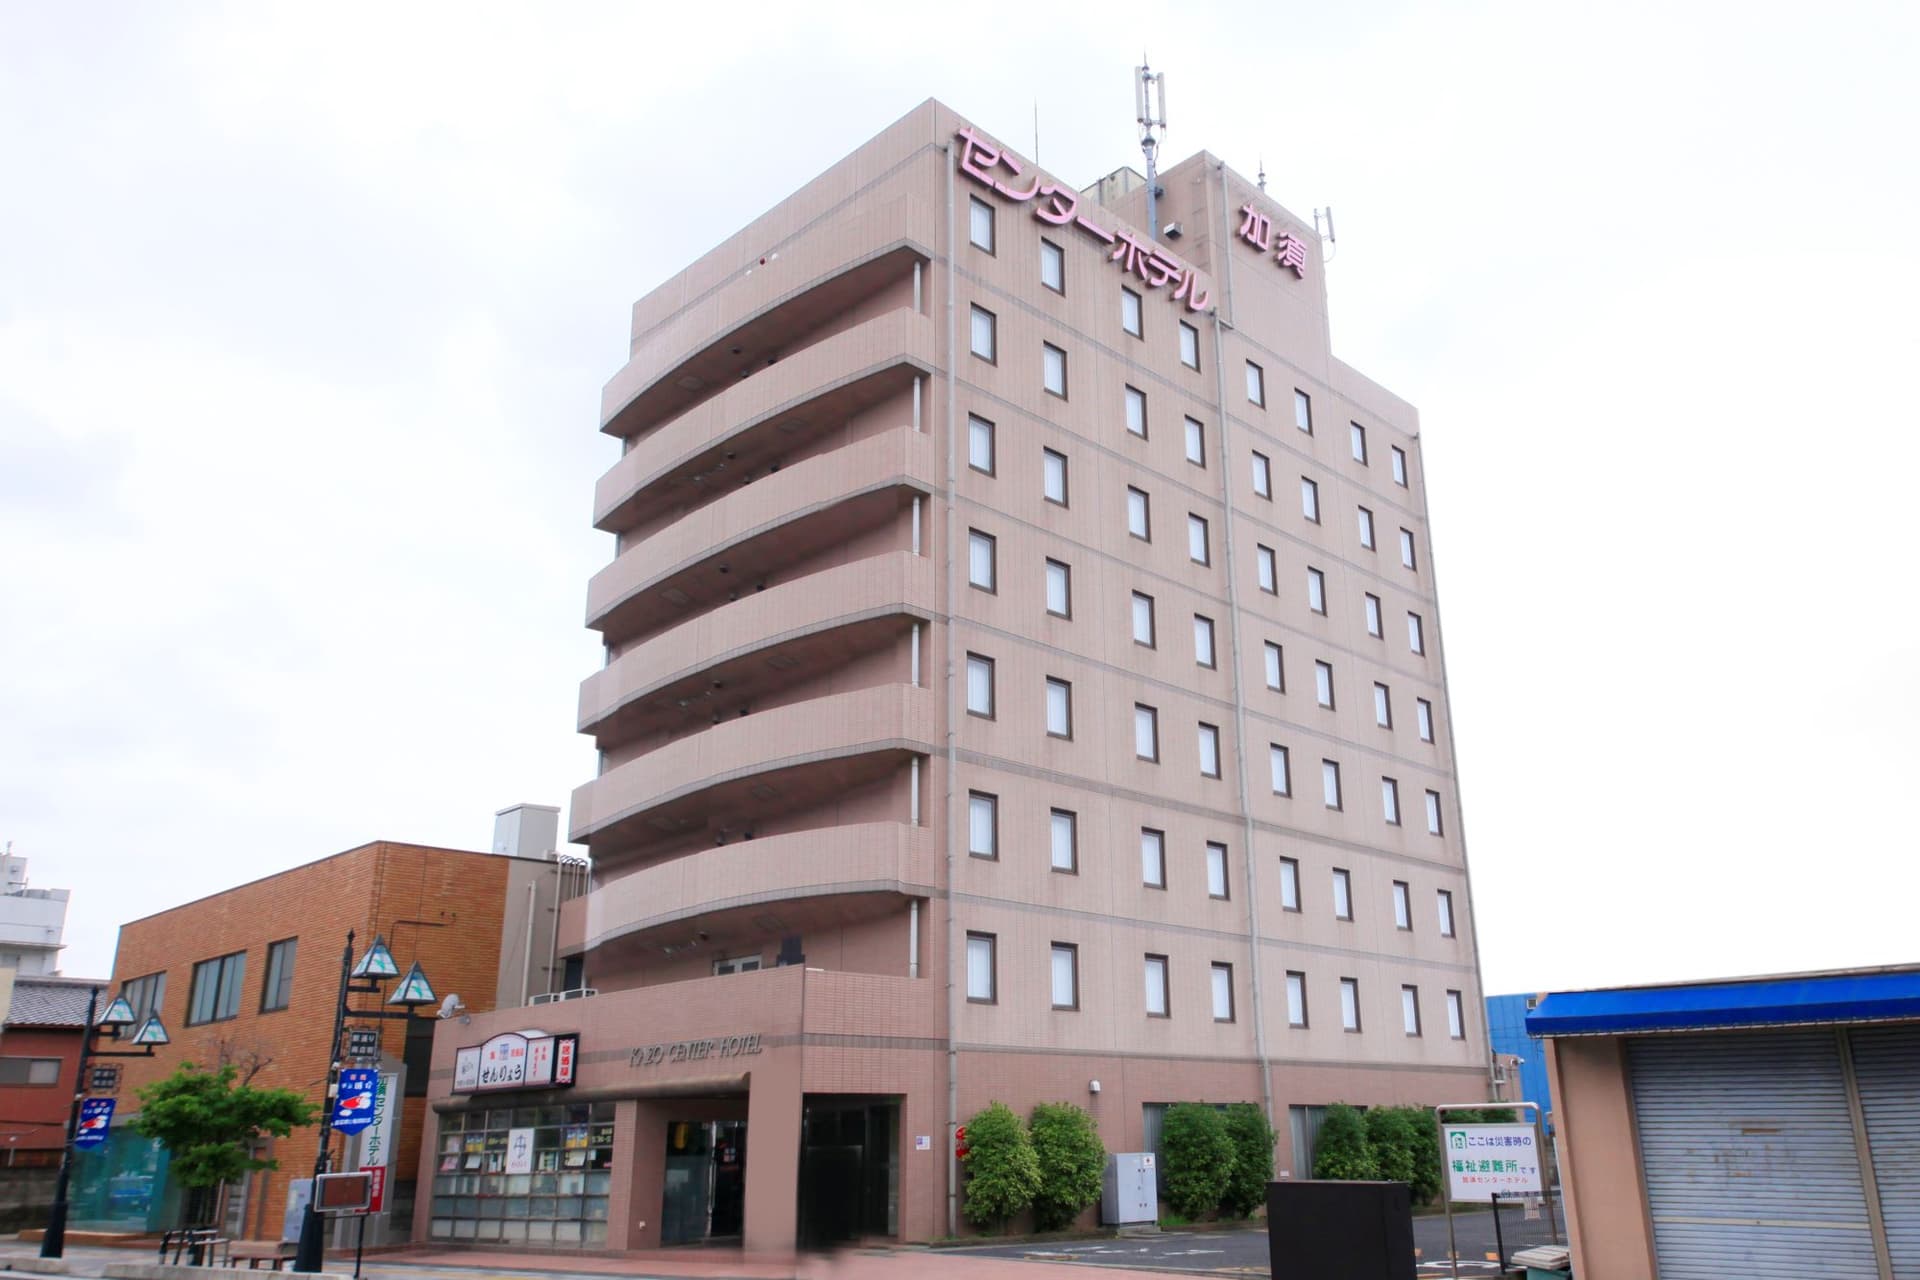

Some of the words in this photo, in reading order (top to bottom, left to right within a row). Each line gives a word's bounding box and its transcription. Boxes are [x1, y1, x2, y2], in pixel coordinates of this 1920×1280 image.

[956, 126, 1210, 312] センターホテル
[1238, 203, 1308, 281] 加須
[669, 1038, 714, 1063] CENTER
[719, 1032, 763, 1058] HOTEL
[481, 1063, 522, 1084] せんりょう
[1468, 1136, 1532, 1147] ここは災害時の
